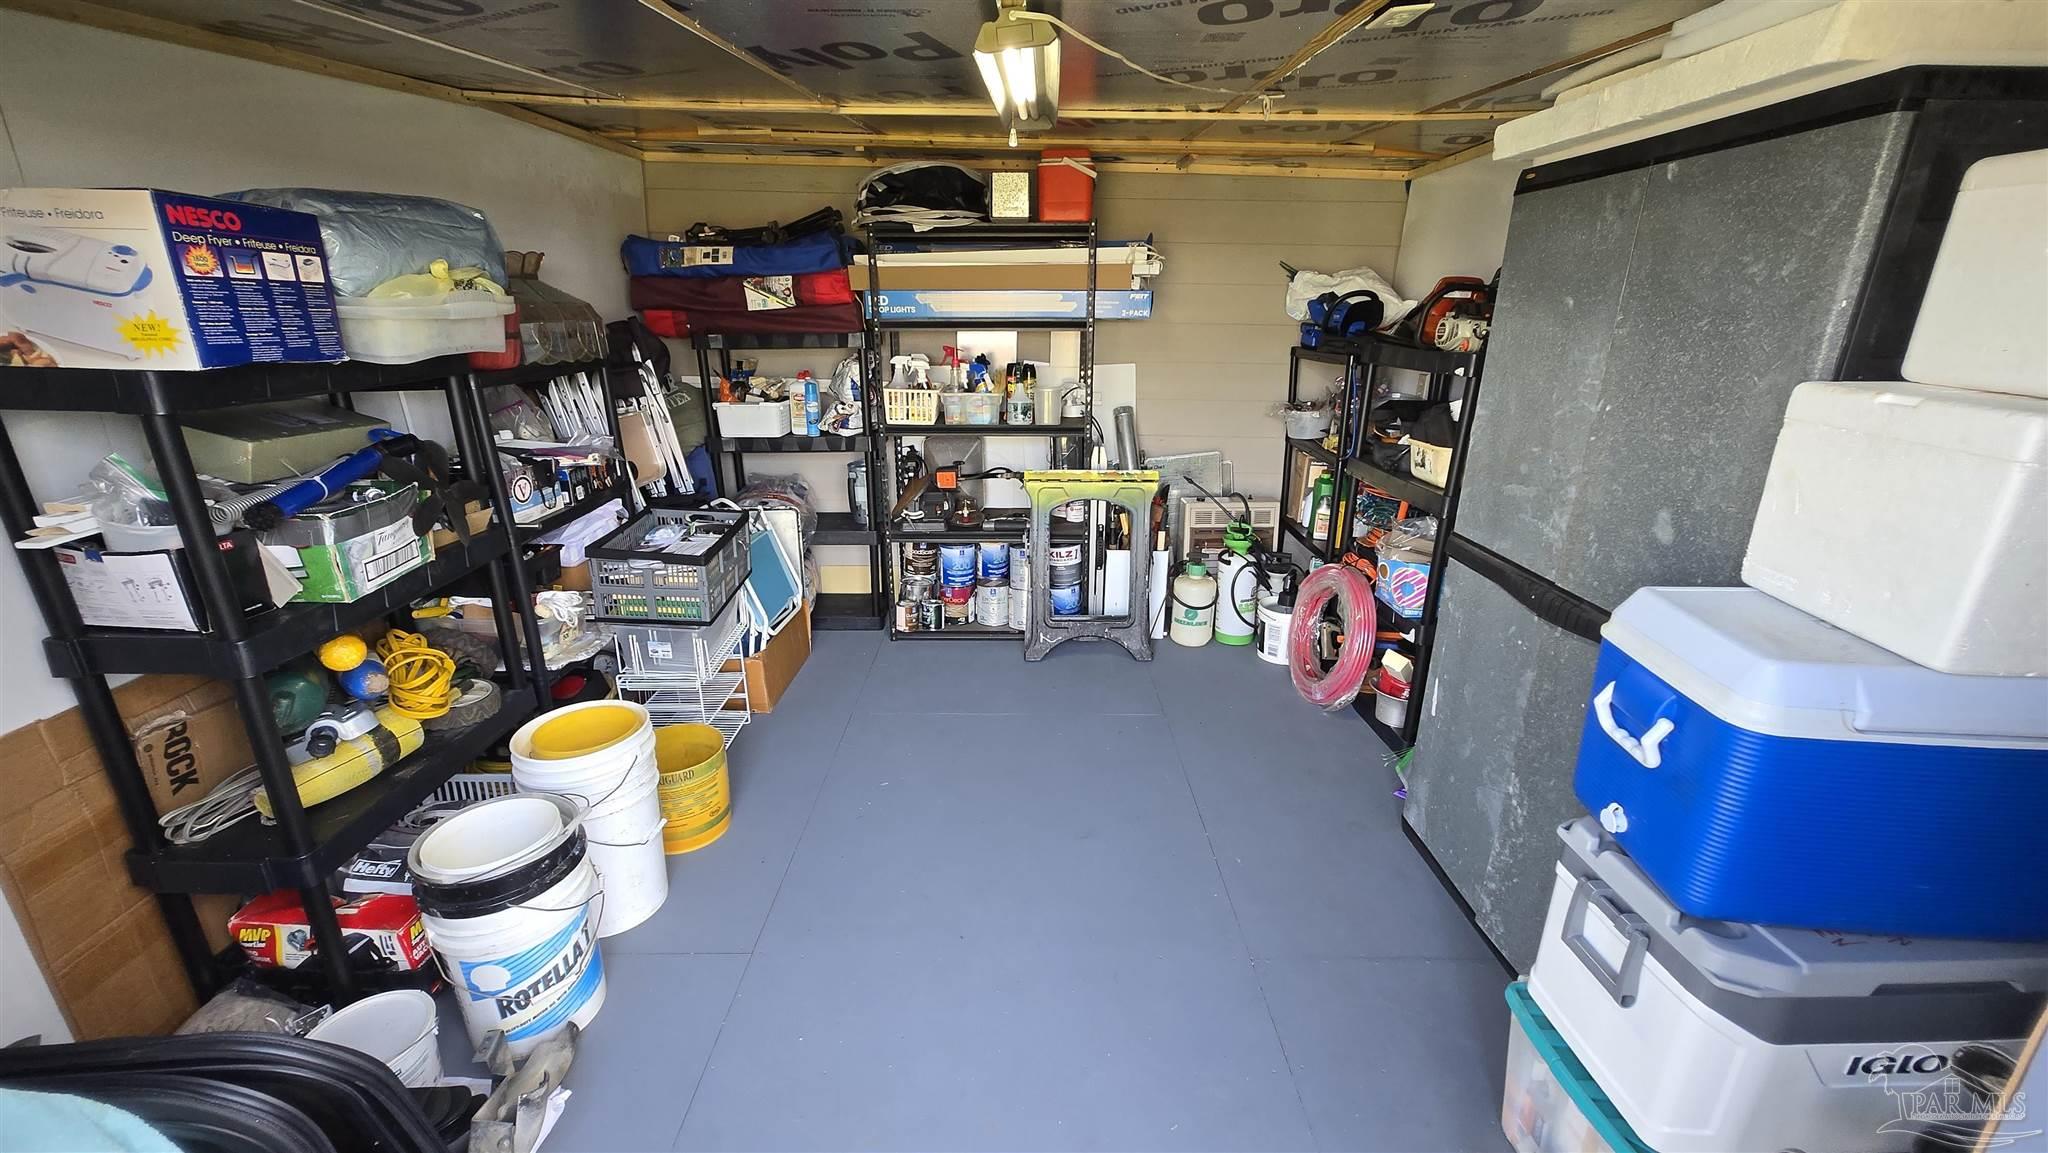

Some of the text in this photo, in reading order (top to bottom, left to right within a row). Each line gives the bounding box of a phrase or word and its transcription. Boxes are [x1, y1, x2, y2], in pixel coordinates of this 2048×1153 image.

[1464, 18, 1526, 32] FOAM
[1531, 8, 1617, 24] BOARD
[0, 206, 104, 219] Friteuse Freidora
[165, 203, 241, 231] NESCO
[171, 231, 316, 254] Deep Fryer Friteuse Freidora
[1129, 293, 1150, 301] FEIT
[891, 306, 916, 314] LIGHTS
[1121, 309, 1149, 318] 2-PACK
[133, 323, 161, 333] NEW!
[1049, 550, 1073, 559] KILZ
[164, 719, 199, 796] ROCK
[352, 861, 395, 876] Hefty
[239, 927, 271, 942] MVP
[496, 940, 584, 1019] ROTELLA
[1844, 1055, 1949, 1076] IGLO
